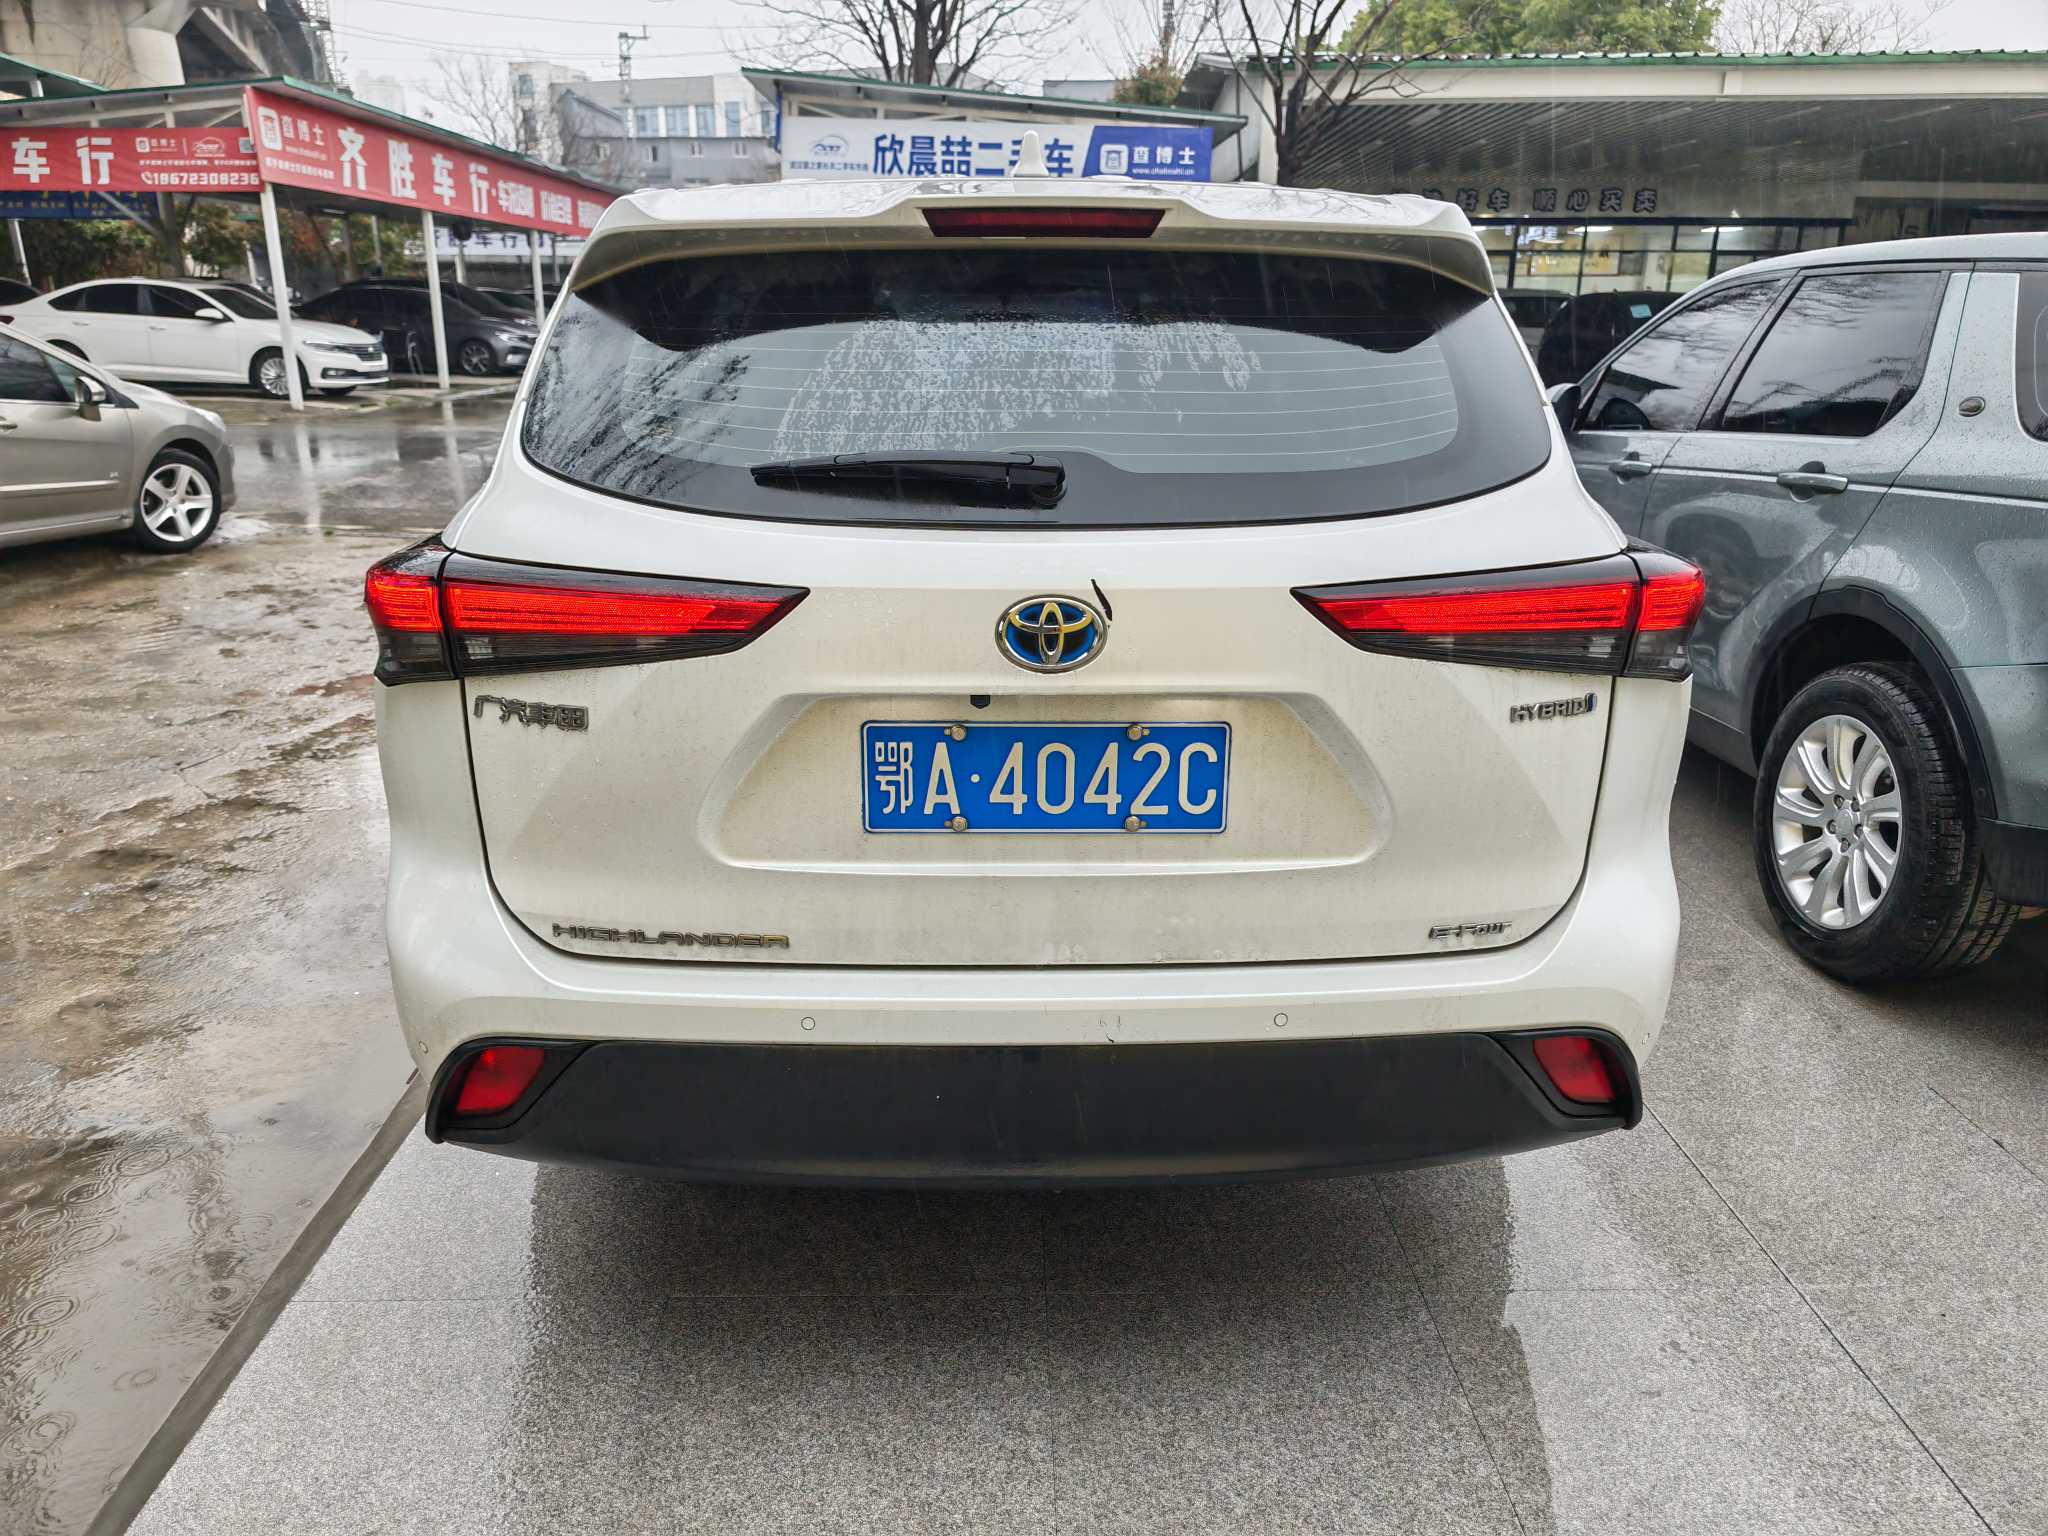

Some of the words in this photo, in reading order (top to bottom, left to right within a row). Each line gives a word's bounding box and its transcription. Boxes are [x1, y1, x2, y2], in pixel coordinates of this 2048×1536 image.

[11, 136, 114, 185] 车行
[337, 126, 489, 214] 齐胜车行
[1533, 188, 1658, 213] 顺心买卖
[1510, 697, 1588, 723] HYBRID
[874, 741, 1218, 816] 鄂A·4042C
[551, 923, 790, 949] HIGHLANDER
